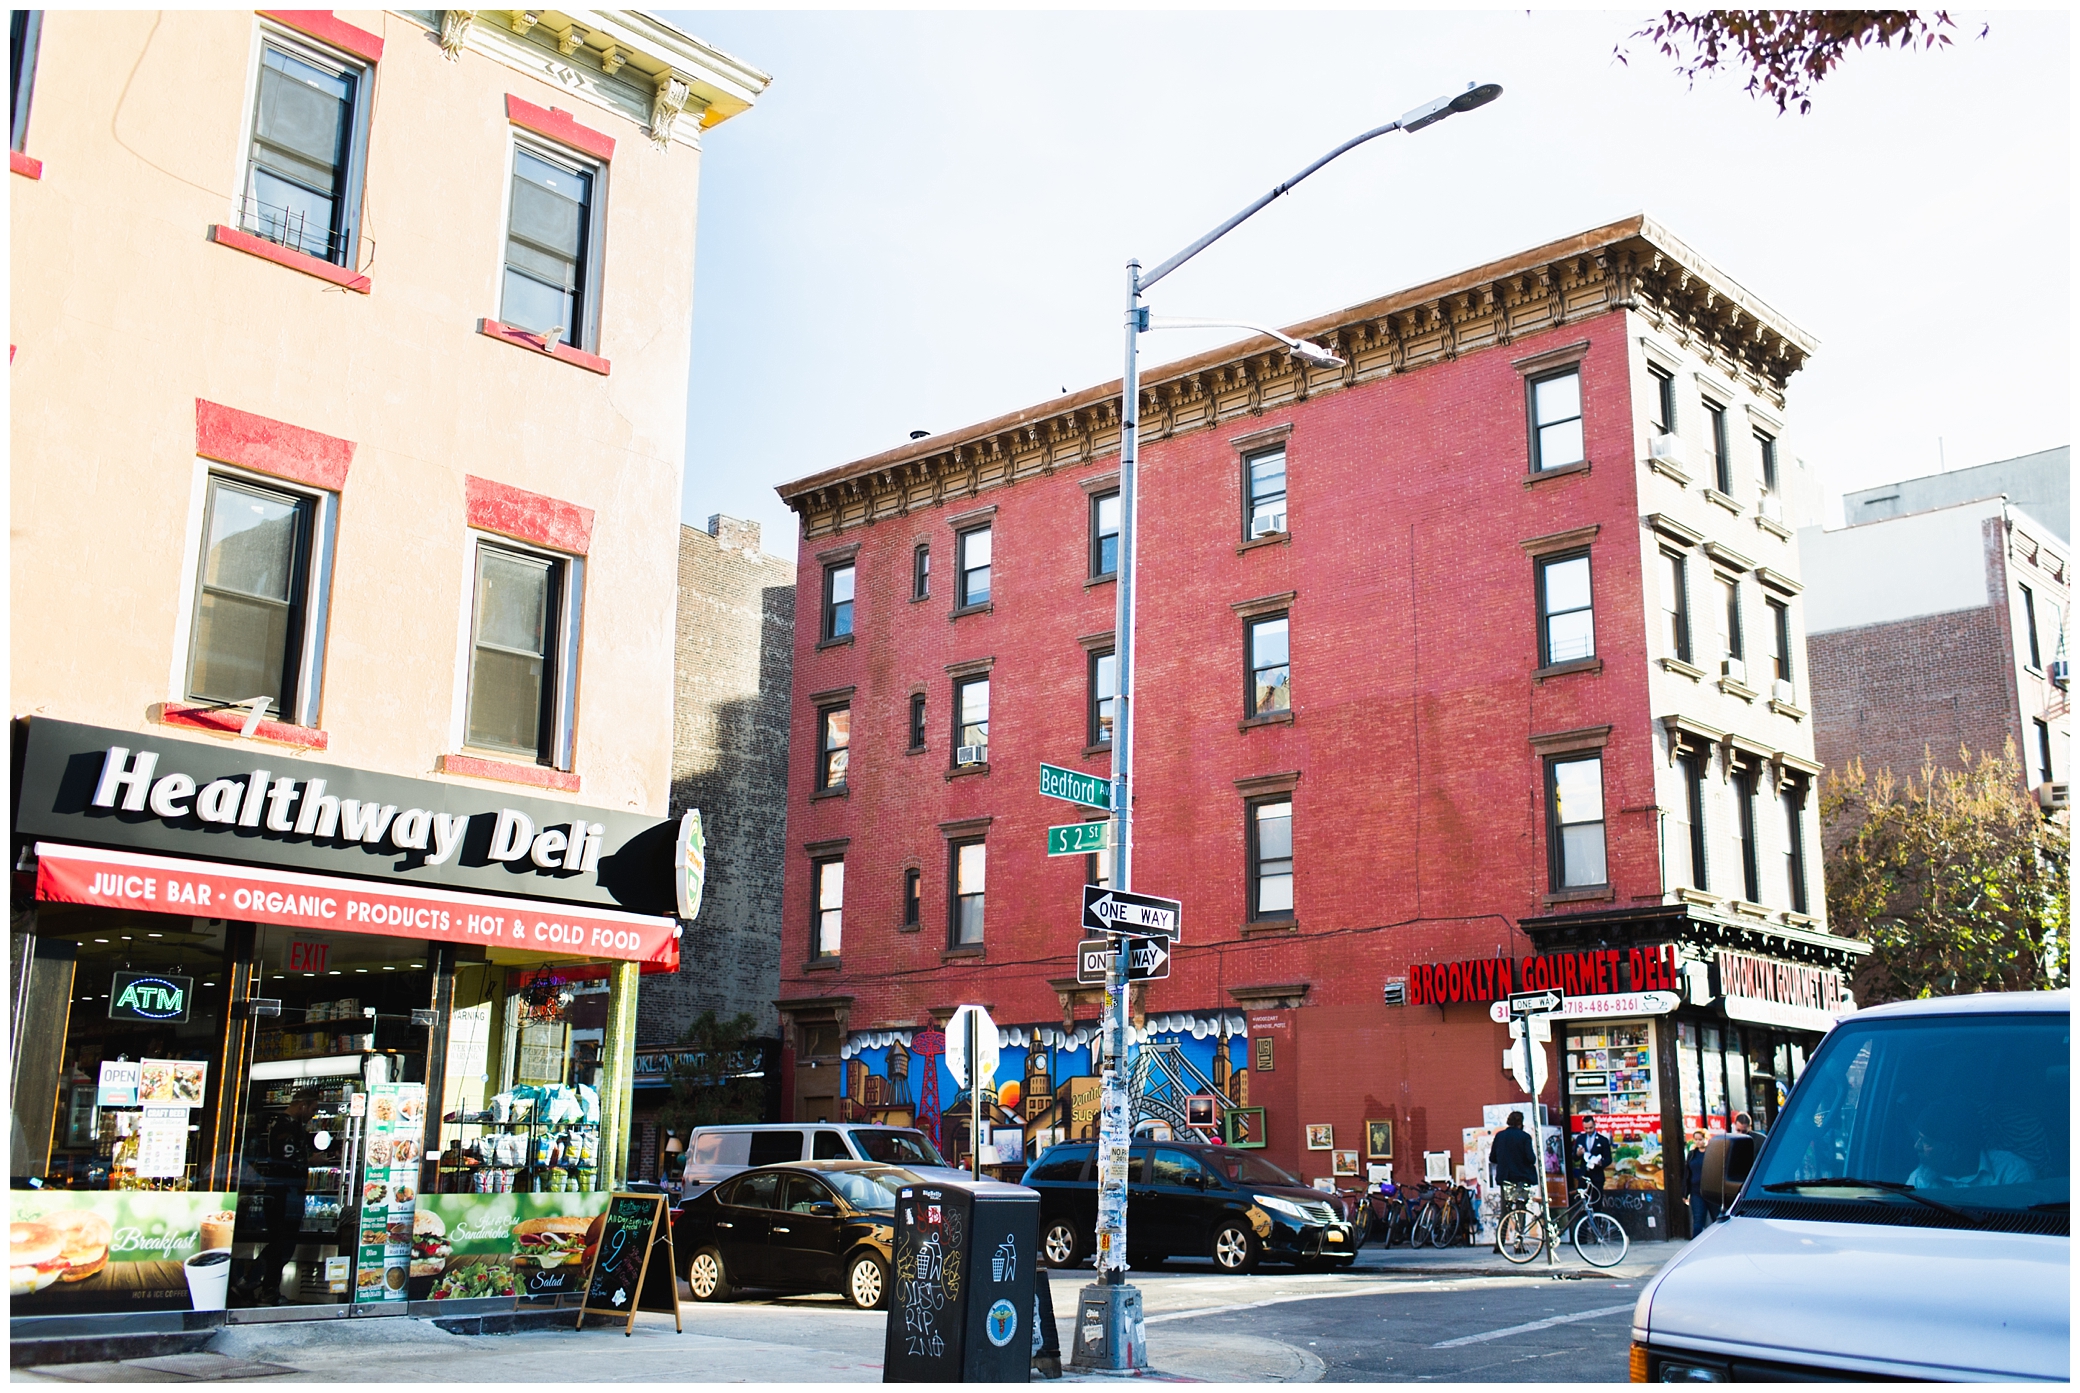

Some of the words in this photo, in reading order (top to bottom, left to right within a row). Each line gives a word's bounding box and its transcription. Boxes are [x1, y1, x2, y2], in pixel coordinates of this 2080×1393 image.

[1041, 768, 1095, 803] Bedford
[92, 746, 470, 864] Healthway
[488, 808, 606, 873] Deli
[1060, 830, 1067, 851] S
[1074, 828, 1083, 850] 2
[1089, 826, 1099, 838] St
[88, 872, 157, 902] JUICE
[167, 879, 211, 905] BAR
[233, 886, 337, 919] ORGANIC
[347, 900, 450, 933] PRODUCTS
[468, 914, 503, 937] HOT
[513, 917, 526, 938] &
[534, 918, 584, 946] COLD
[592, 926, 641, 951] FOOD
[1099, 901, 1128, 920] ONE
[1141, 908, 1168, 927] WAY
[289, 941, 330, 973] EXIT
[1087, 954, 1106, 969] ON
[1132, 950, 1158, 967] WAY
[1410, 957, 1512, 1005] BROOKLYN
[1522, 950, 1620, 996] GOURMET
[1629, 945, 1676, 991] DELI
[1719, 950, 1775, 1002] BROOKLYN
[1776, 962, 1822, 1011] GOURMET
[116, 985, 183, 1011] ATM
[1497, 1006, 1509, 1018] 31
[1547, 998, 1638, 1017] :718-486-8261
[1517, 999, 1532, 1009] ONE
[1539, 996, 1555, 1006] WAY
[104, 1069, 136, 1083] OPEN
[450, 1222, 510, 1242] Sandwiches
[475, 1216, 493, 1228] Hot
[110, 1227, 198, 1259] Breakfast
[530, 1271, 565, 1289] Salad
[132, 1291, 145, 1299] HOT
[153, 1290, 164, 1298] ICE
[165, 1289, 188, 1298] COFFEE
